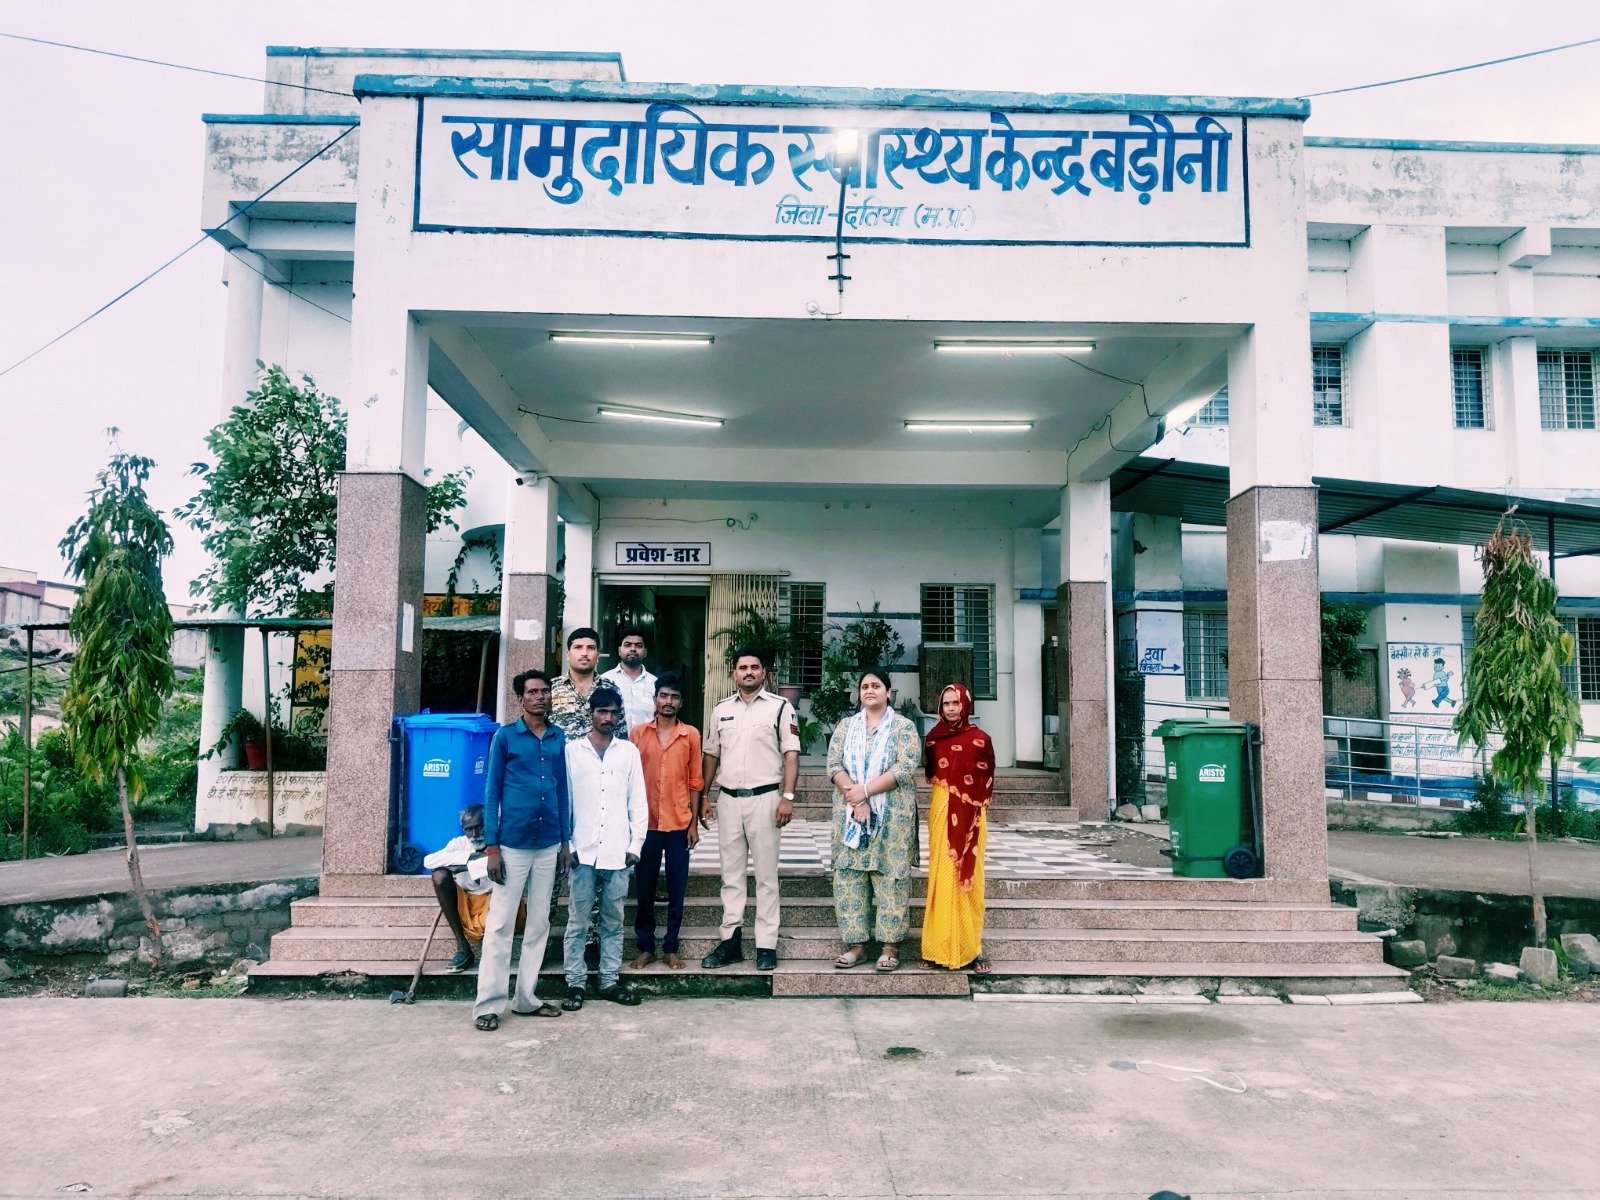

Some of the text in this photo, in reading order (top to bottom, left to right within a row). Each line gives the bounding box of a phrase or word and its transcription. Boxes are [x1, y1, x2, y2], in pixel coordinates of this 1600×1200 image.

[441, 103, 780, 205] सामुदायिक
[985, 112, 1090, 197] केन्द्र
[625, 543, 701, 563] प्रवेश-द्वार
[423, 762, 450, 772] ARISTO
[1199, 768, 1225, 778] ARISTO
